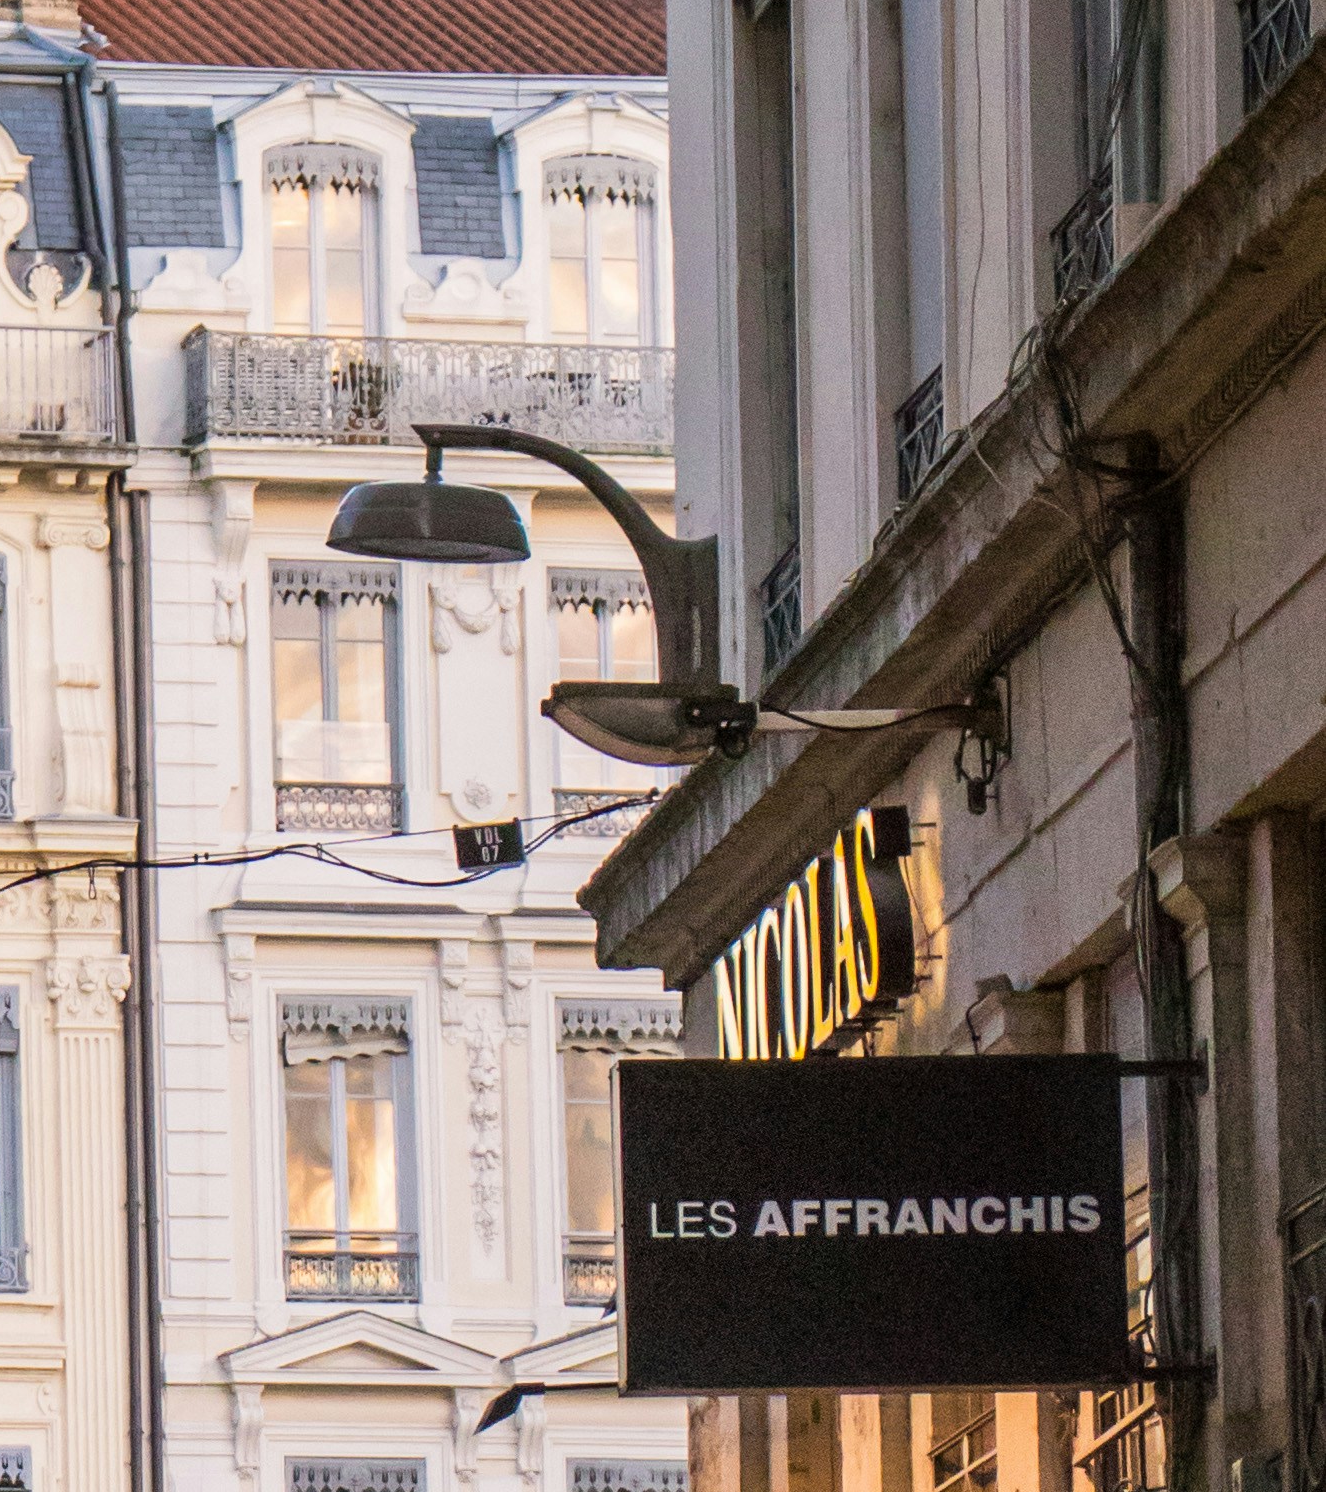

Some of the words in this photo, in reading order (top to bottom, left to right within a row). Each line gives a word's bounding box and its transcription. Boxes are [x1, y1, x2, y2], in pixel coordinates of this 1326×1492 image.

[713, 806, 880, 1060] NICOLAS
[650, 1200, 738, 1239] LES
[753, 1194, 1102, 1237] AFFRANCHIS
